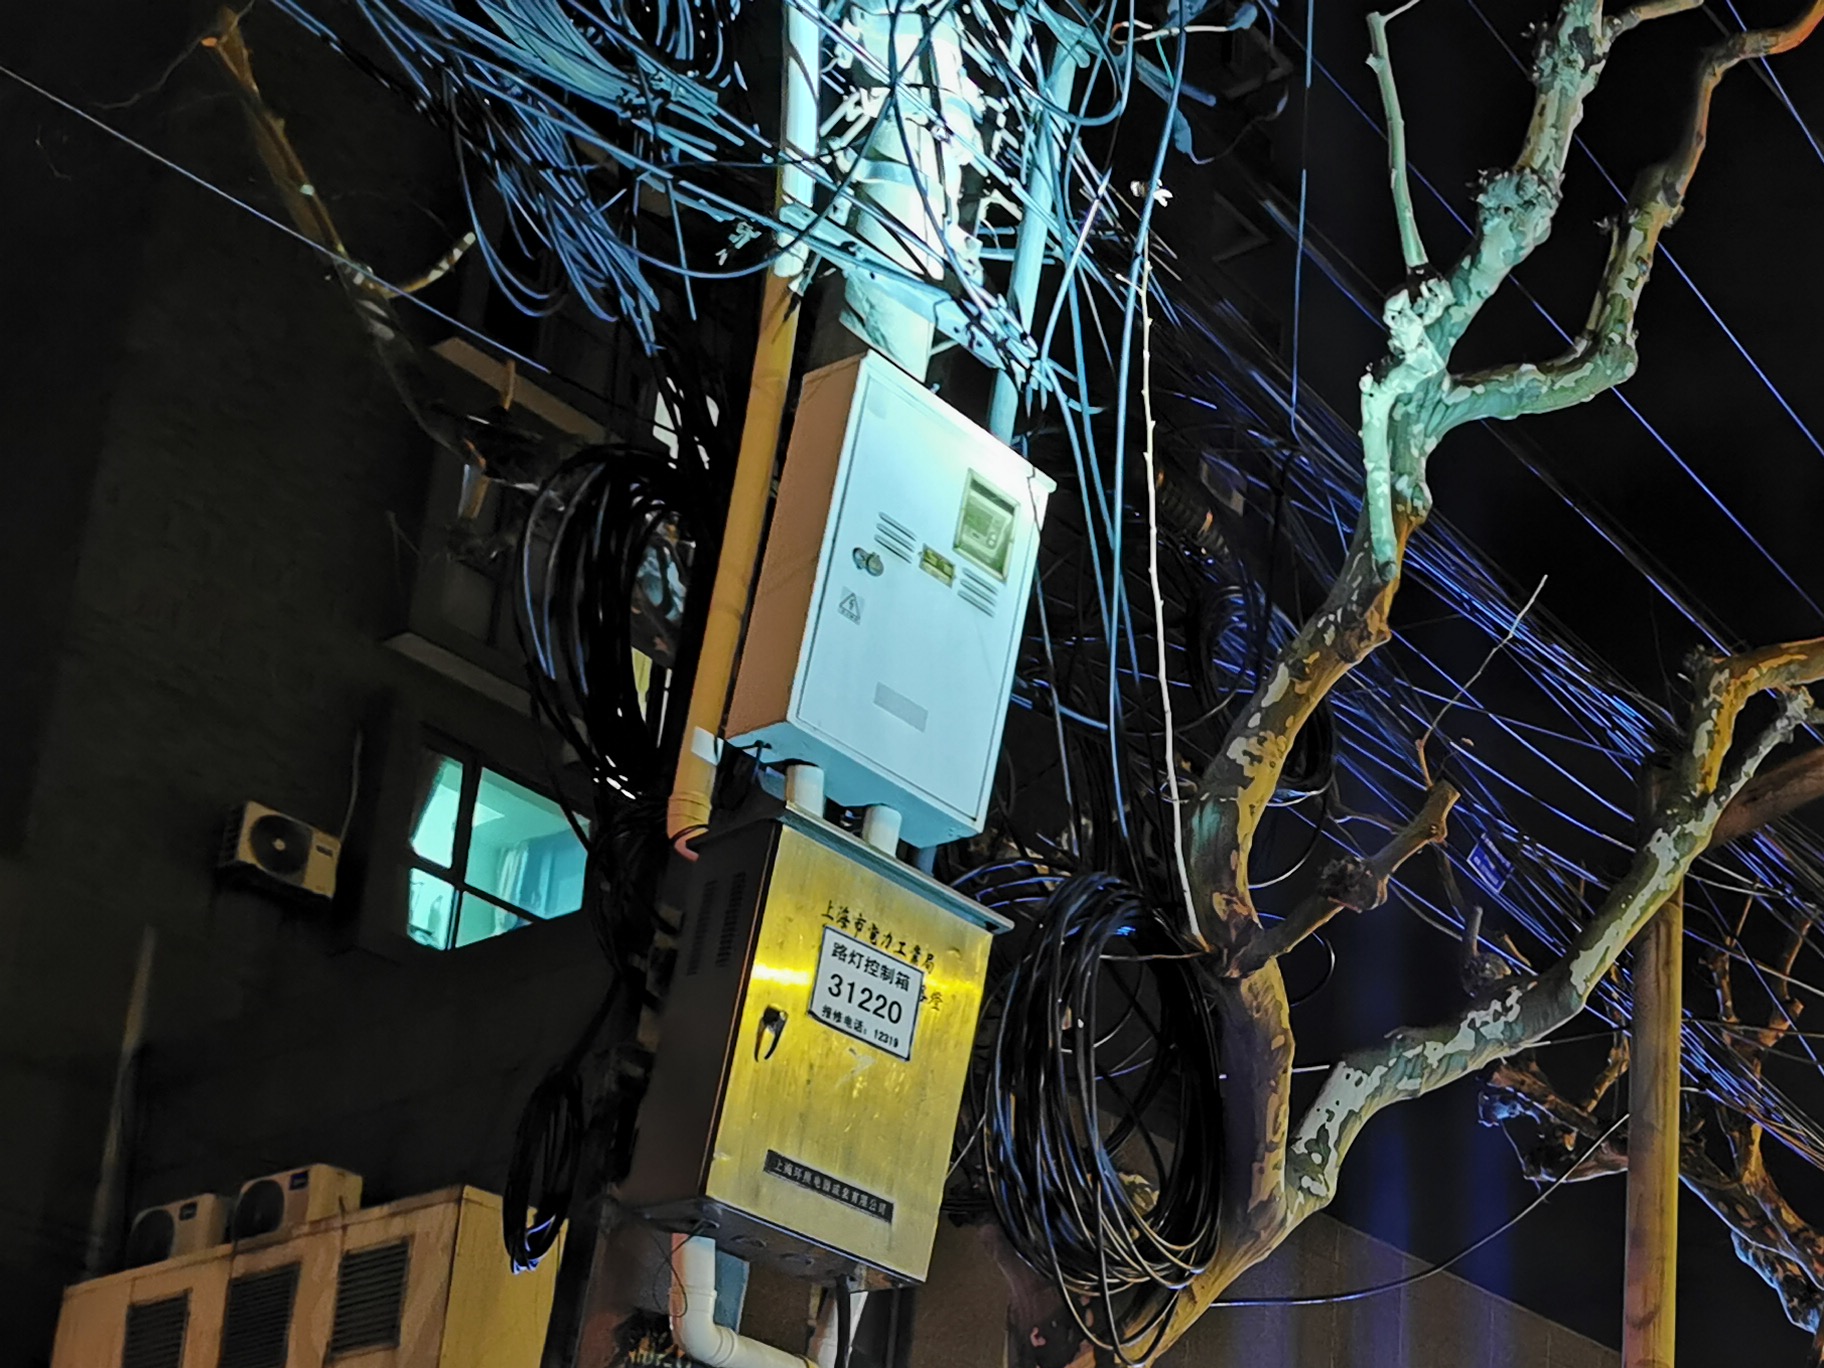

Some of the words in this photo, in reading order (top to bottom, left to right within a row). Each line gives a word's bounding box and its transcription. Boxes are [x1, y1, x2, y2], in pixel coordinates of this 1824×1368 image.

[831, 942, 912, 992] 路灯控制箱
[828, 973, 902, 1024] 31220
